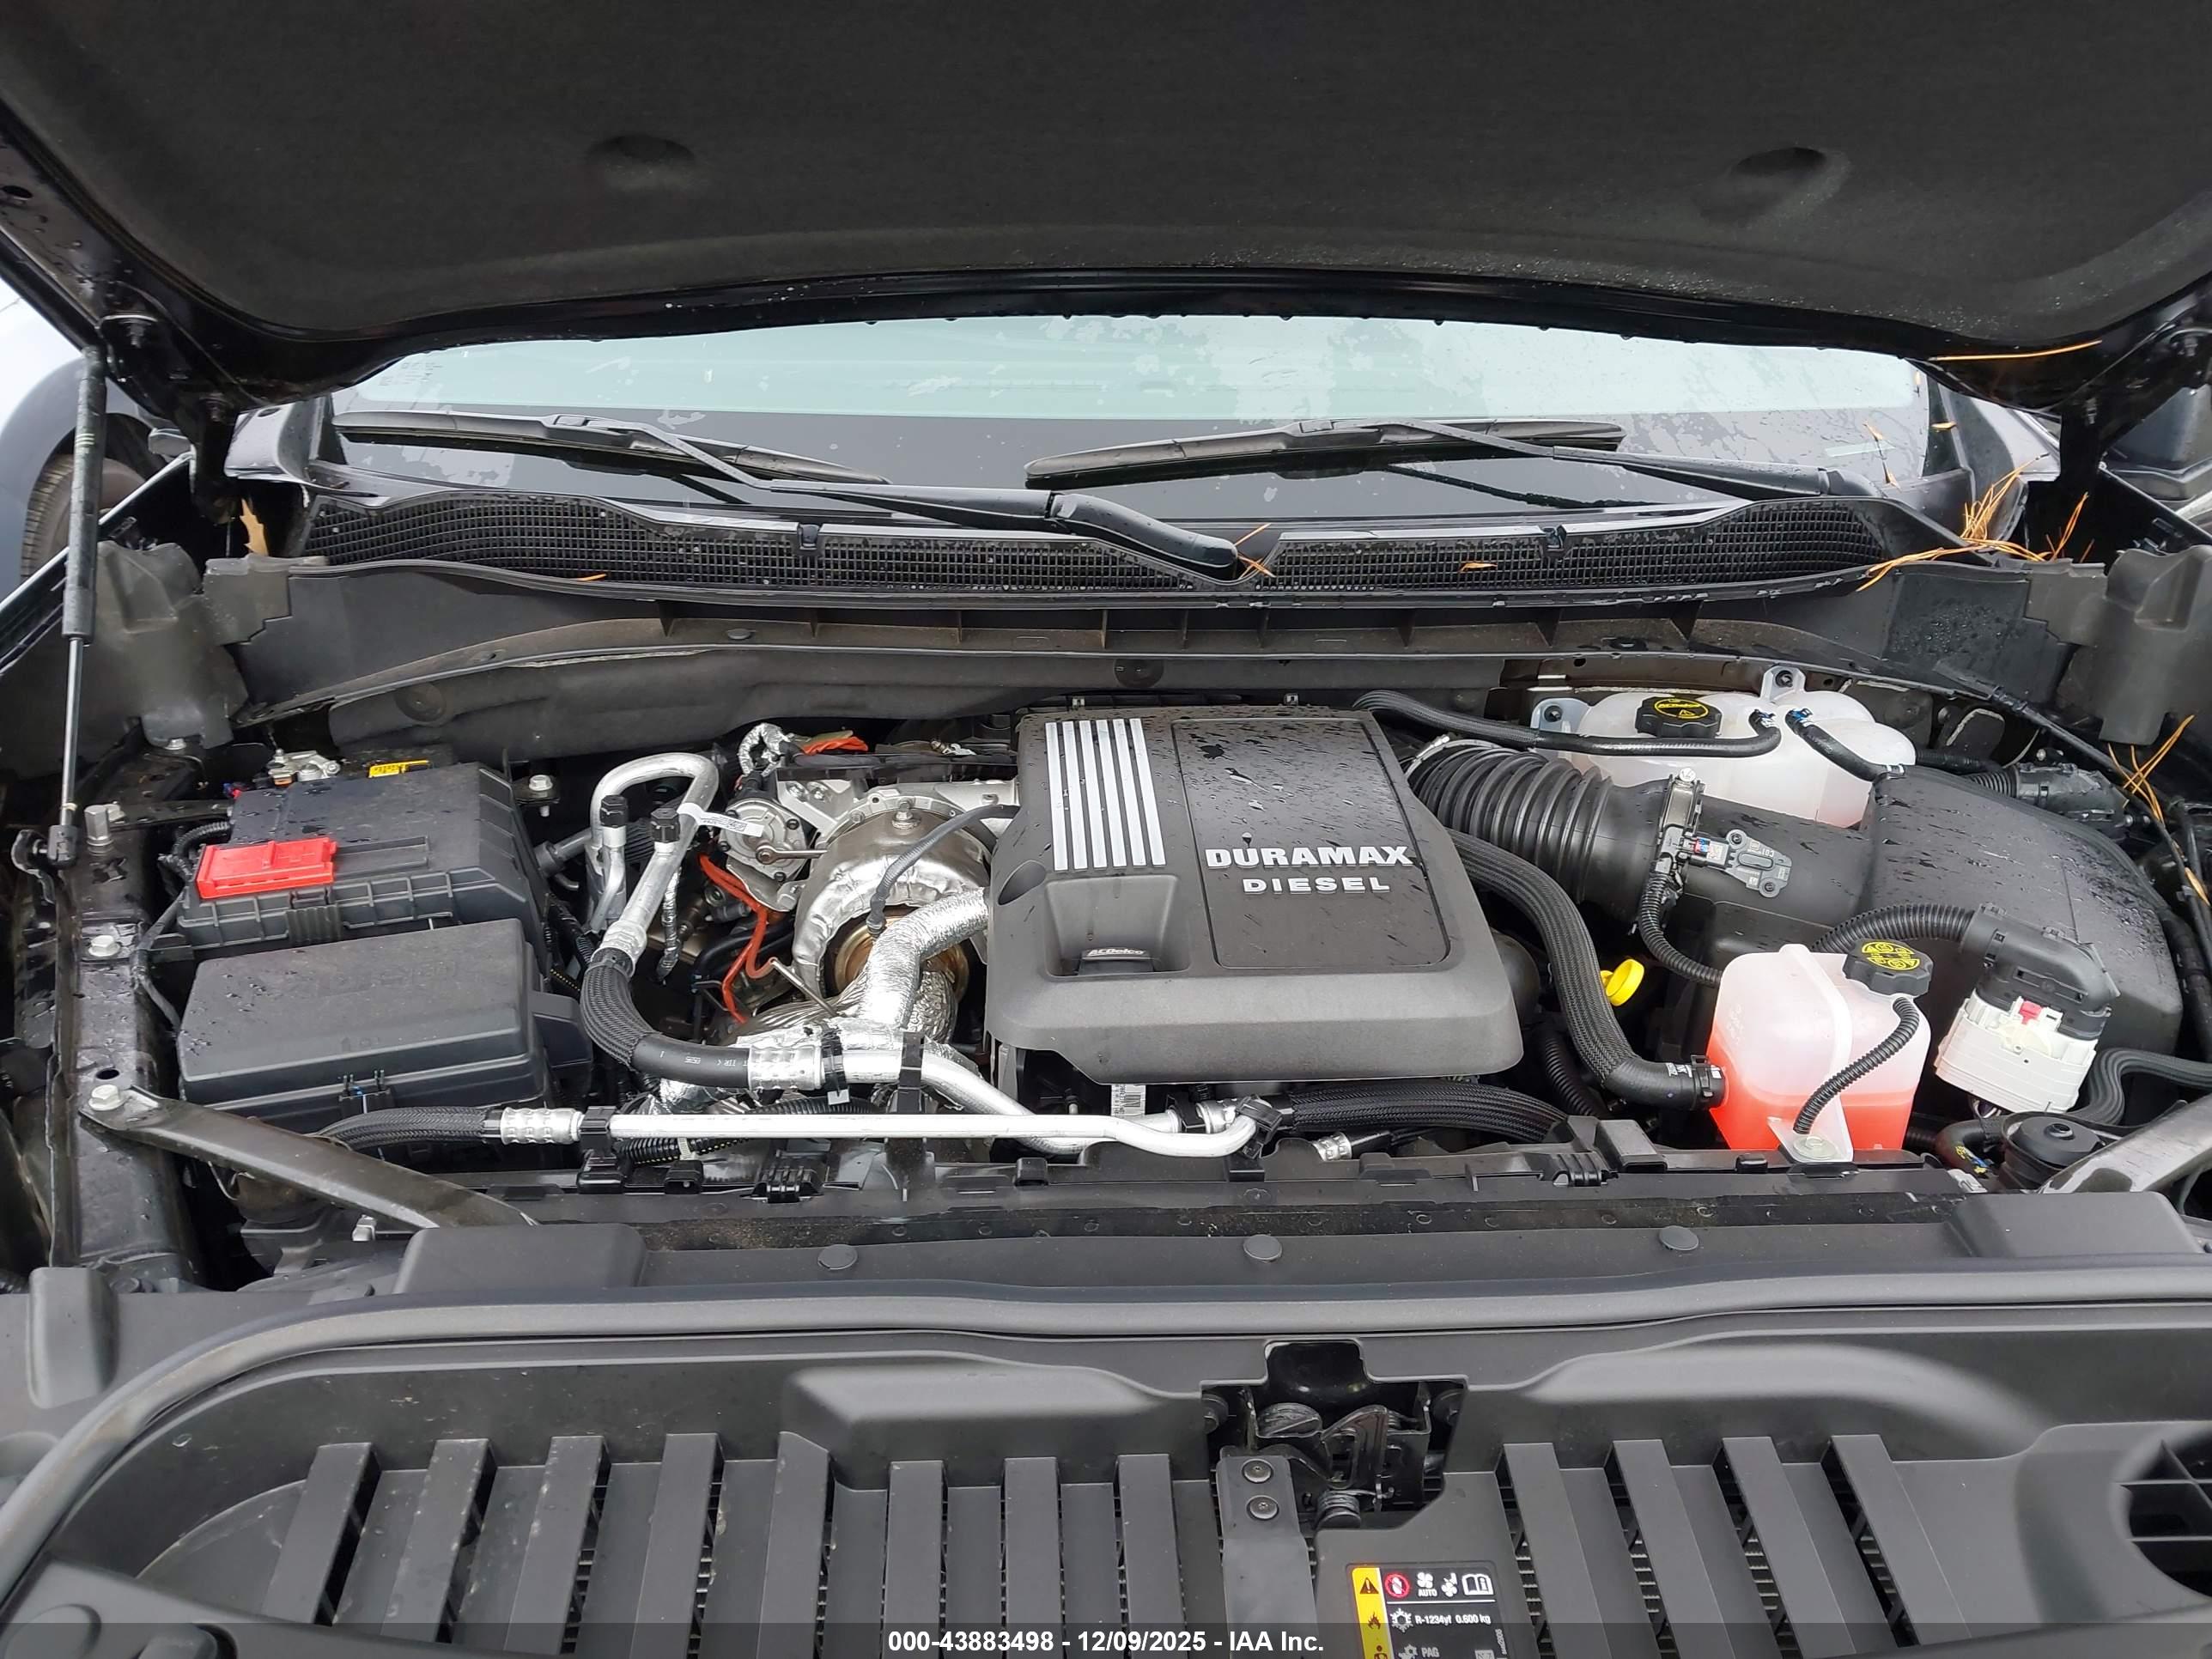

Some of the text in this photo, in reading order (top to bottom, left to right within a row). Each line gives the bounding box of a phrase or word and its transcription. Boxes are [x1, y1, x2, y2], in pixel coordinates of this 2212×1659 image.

[1205, 846, 1415, 868] DURAMAX
[1243, 877, 1390, 894] DIESEL
[1086, 948, 1145, 957] ACDelco
[1418, 1589, 1437, 1597] AUTO
[1414, 1613, 1492, 1626] R-1234yf 0.600 kg
[1421, 1646, 1440, 1658] PAG
